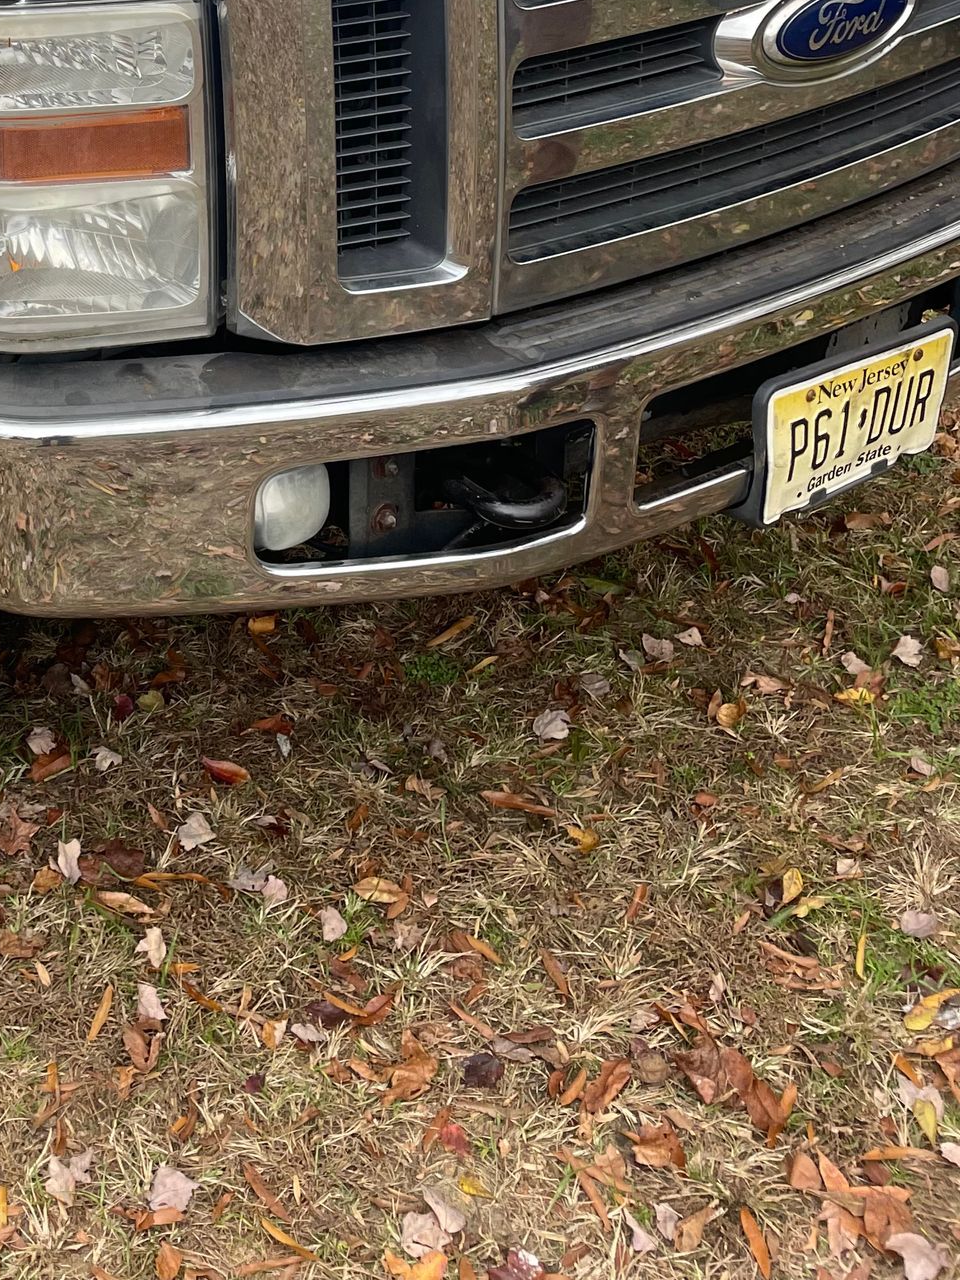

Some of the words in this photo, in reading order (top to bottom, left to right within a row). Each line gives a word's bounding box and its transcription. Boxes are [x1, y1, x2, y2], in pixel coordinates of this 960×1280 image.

[816, 378, 858, 404] New
[858, 358, 910, 394] Jersey
[807, 463, 852, 493] Garden
[855, 444, 892, 468] State
